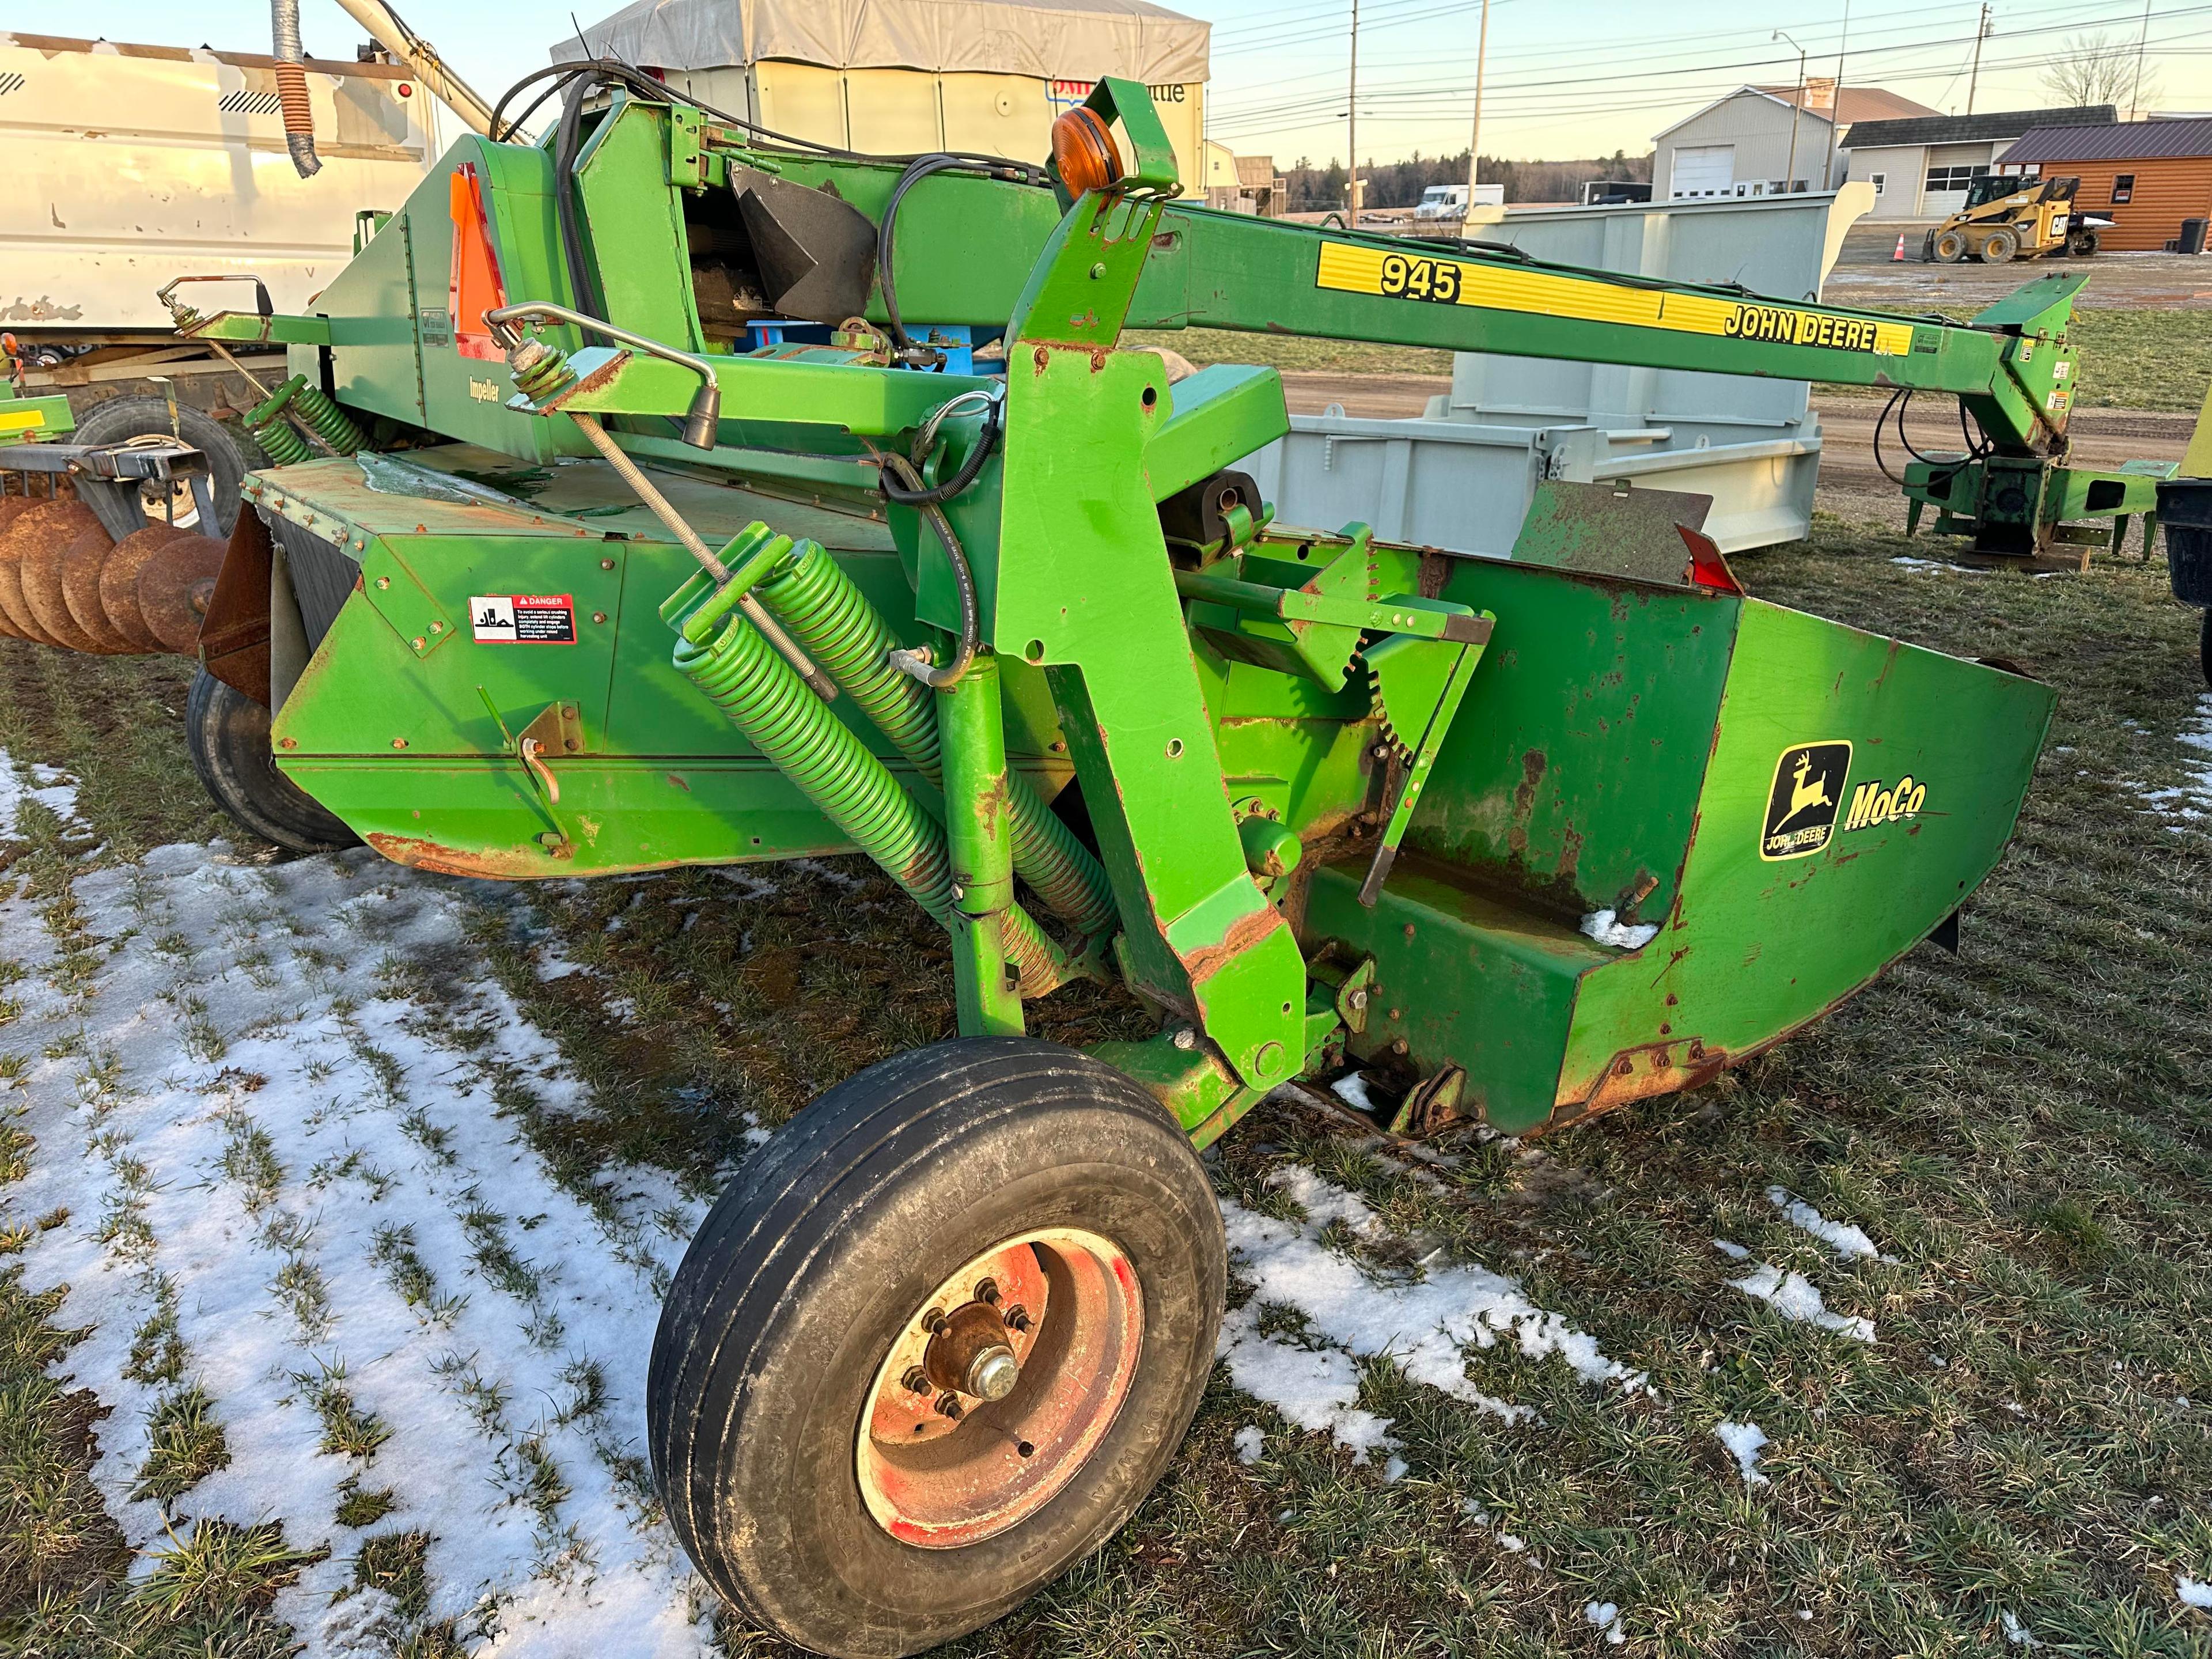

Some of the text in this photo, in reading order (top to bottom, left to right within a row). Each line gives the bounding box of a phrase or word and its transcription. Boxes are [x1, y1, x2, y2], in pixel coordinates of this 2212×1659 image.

[2051, 215, 2068, 235] CAT
[1381, 255, 1461, 304] 945
[1725, 305, 1878, 353] JOHN DEERE
[469, 374, 499, 404] Impeller
[1843, 774, 1927, 834] MoCo
[1796, 827, 1827, 845] DEERE
[1092, 1448, 1140, 1510] MAX
